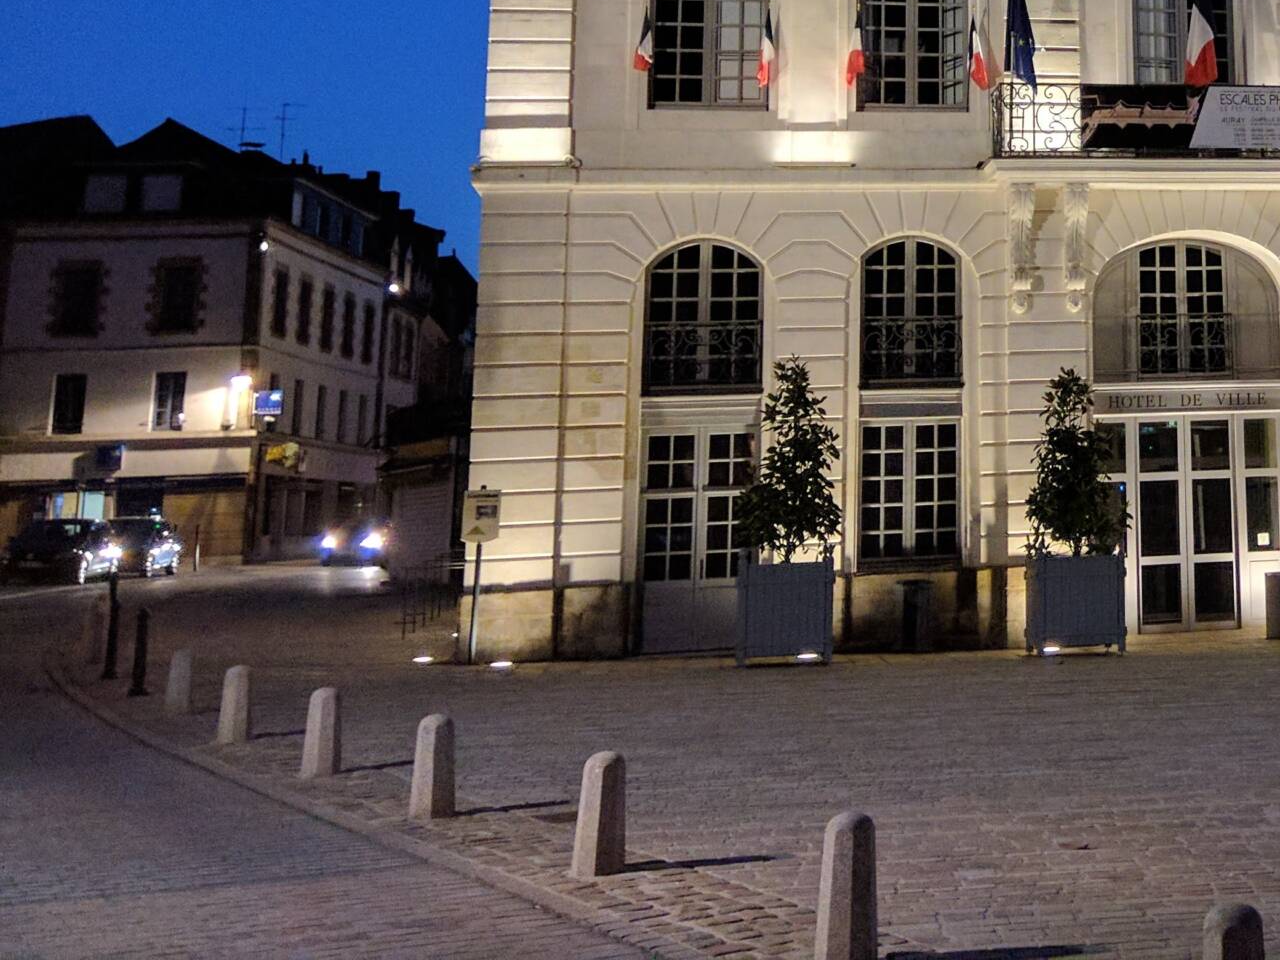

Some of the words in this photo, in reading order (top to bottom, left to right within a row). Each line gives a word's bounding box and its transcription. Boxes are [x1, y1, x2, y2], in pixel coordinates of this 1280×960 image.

[1220, 93, 1267, 106] ESCALES
[1109, 394, 1167, 409] HOTEL
[1181, 394, 1202, 408] DE
[1216, 392, 1267, 407] VILLE
